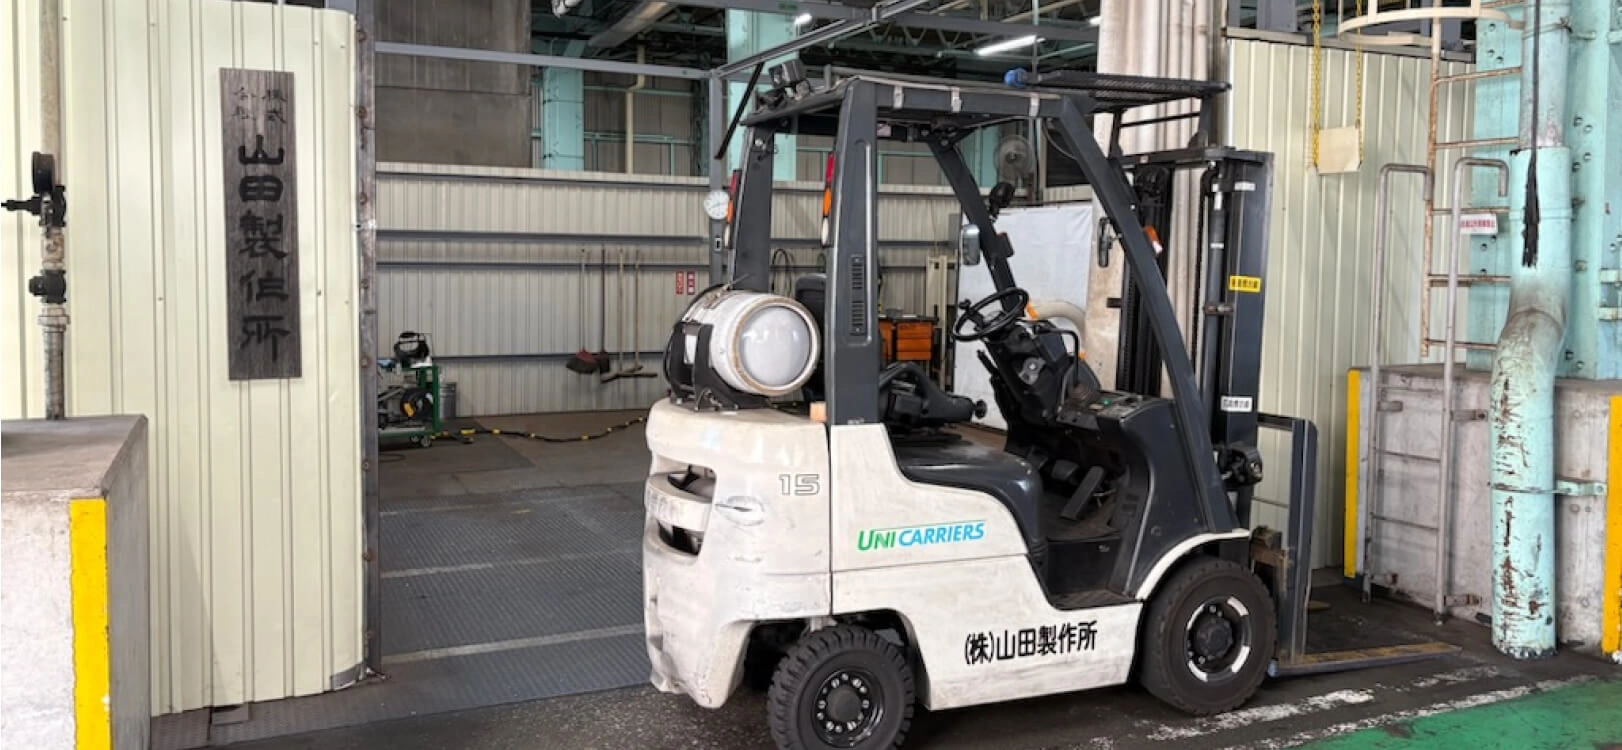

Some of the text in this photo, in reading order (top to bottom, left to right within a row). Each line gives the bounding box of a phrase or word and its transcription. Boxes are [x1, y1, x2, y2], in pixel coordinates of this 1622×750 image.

[238, 134, 291, 363] 山田製作所
[778, 473, 821, 496] 15
[965, 620, 1098, 665] (株)山田製作所
